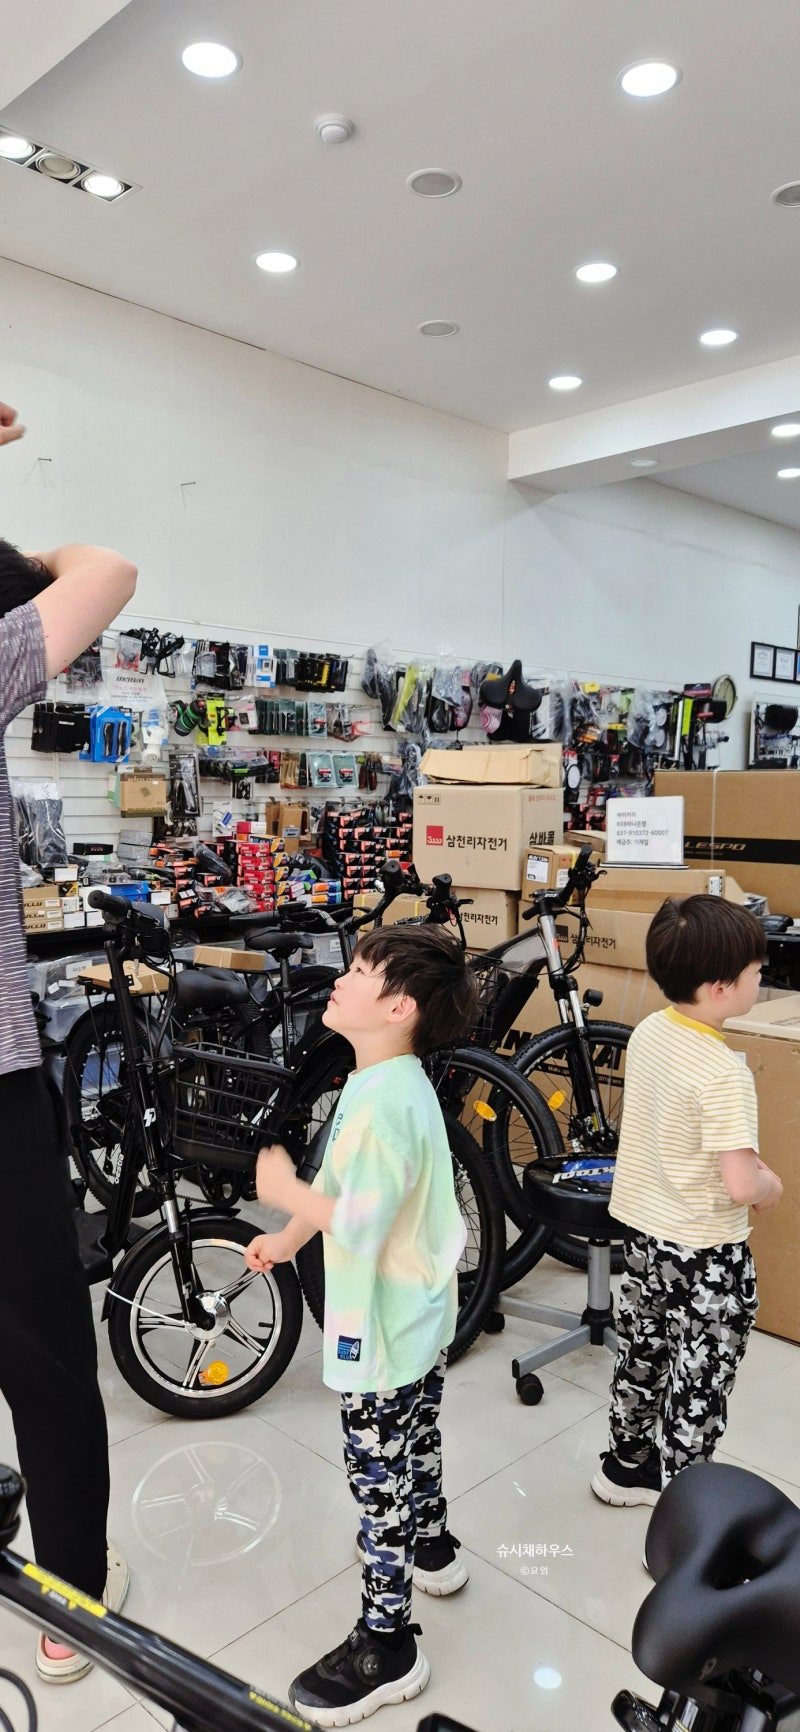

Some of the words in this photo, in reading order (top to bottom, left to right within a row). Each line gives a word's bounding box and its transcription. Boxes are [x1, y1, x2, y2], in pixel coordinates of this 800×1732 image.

[446, 835, 507, 851] 삼천리자전거
[684, 841, 747, 851] LESPO
[570, 933, 616, 949] 삼리자전거
